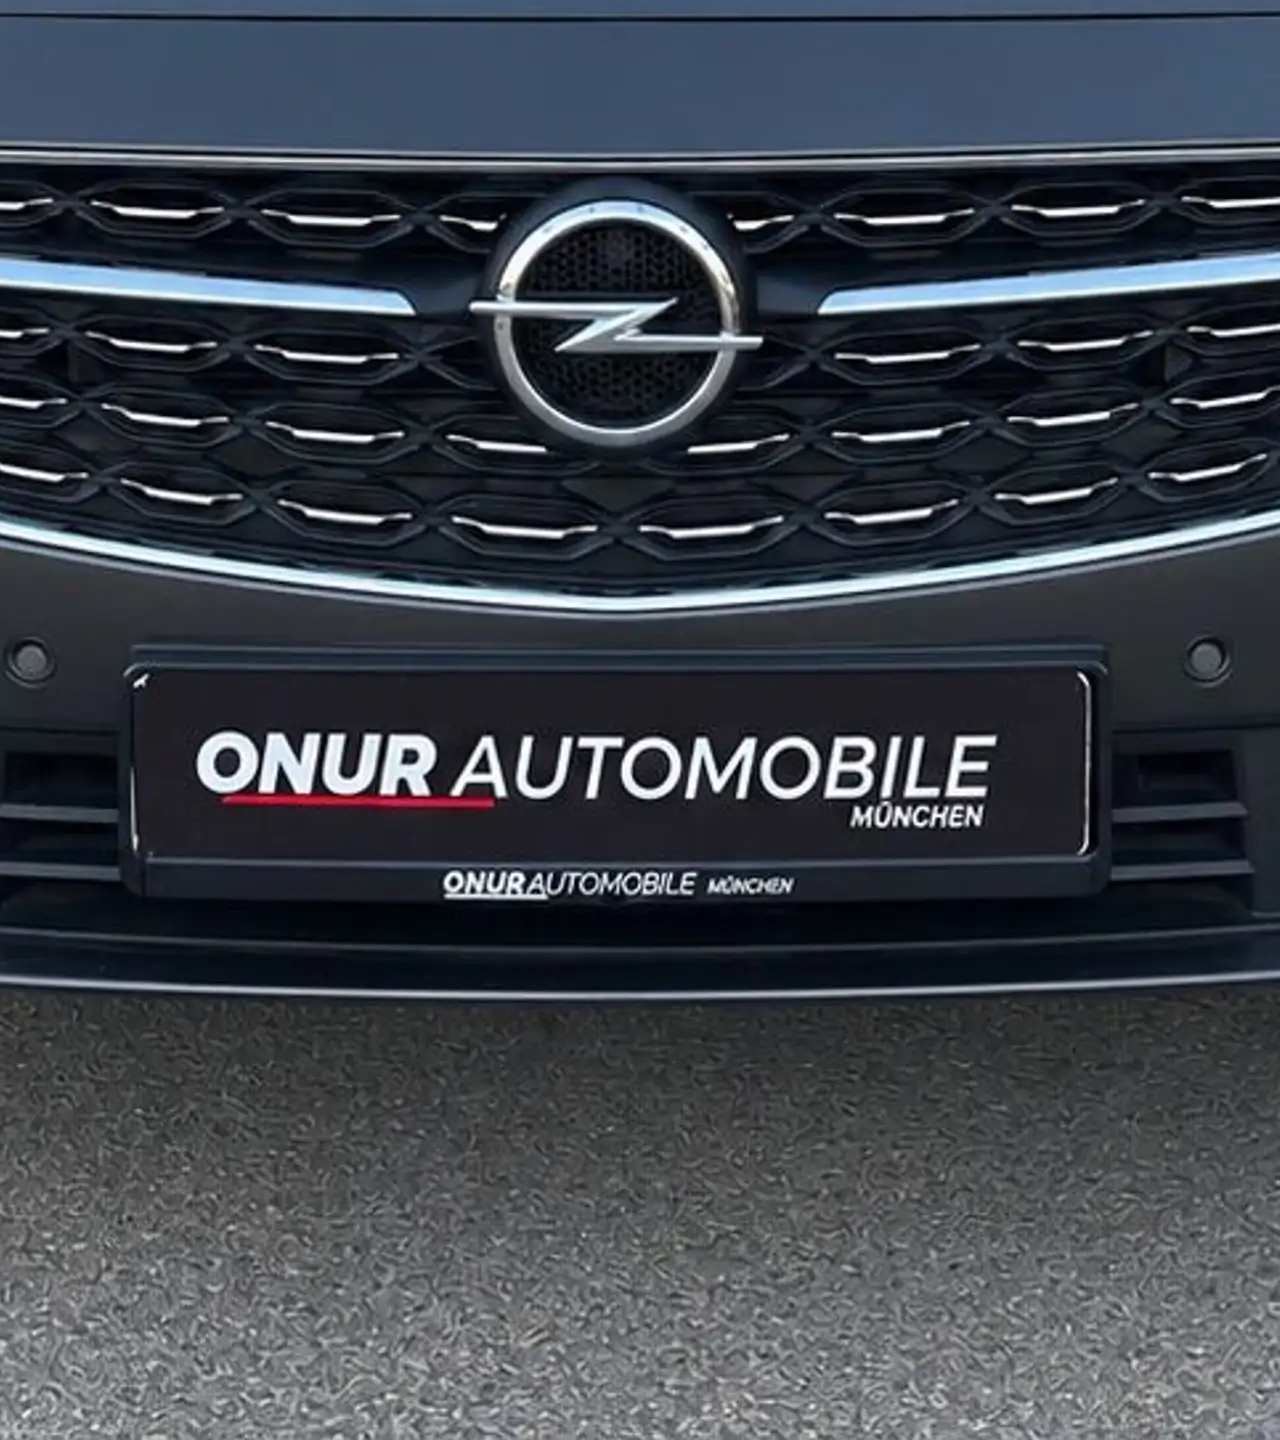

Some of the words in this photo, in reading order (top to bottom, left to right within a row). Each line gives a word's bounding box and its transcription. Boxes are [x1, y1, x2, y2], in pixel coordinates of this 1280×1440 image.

[197, 731, 437, 796] ONUR
[450, 734, 998, 800] AUTOMOBILE
[850, 801, 985, 829] MÜNCHEN
[707, 876, 795, 895] MÜNCHEN
